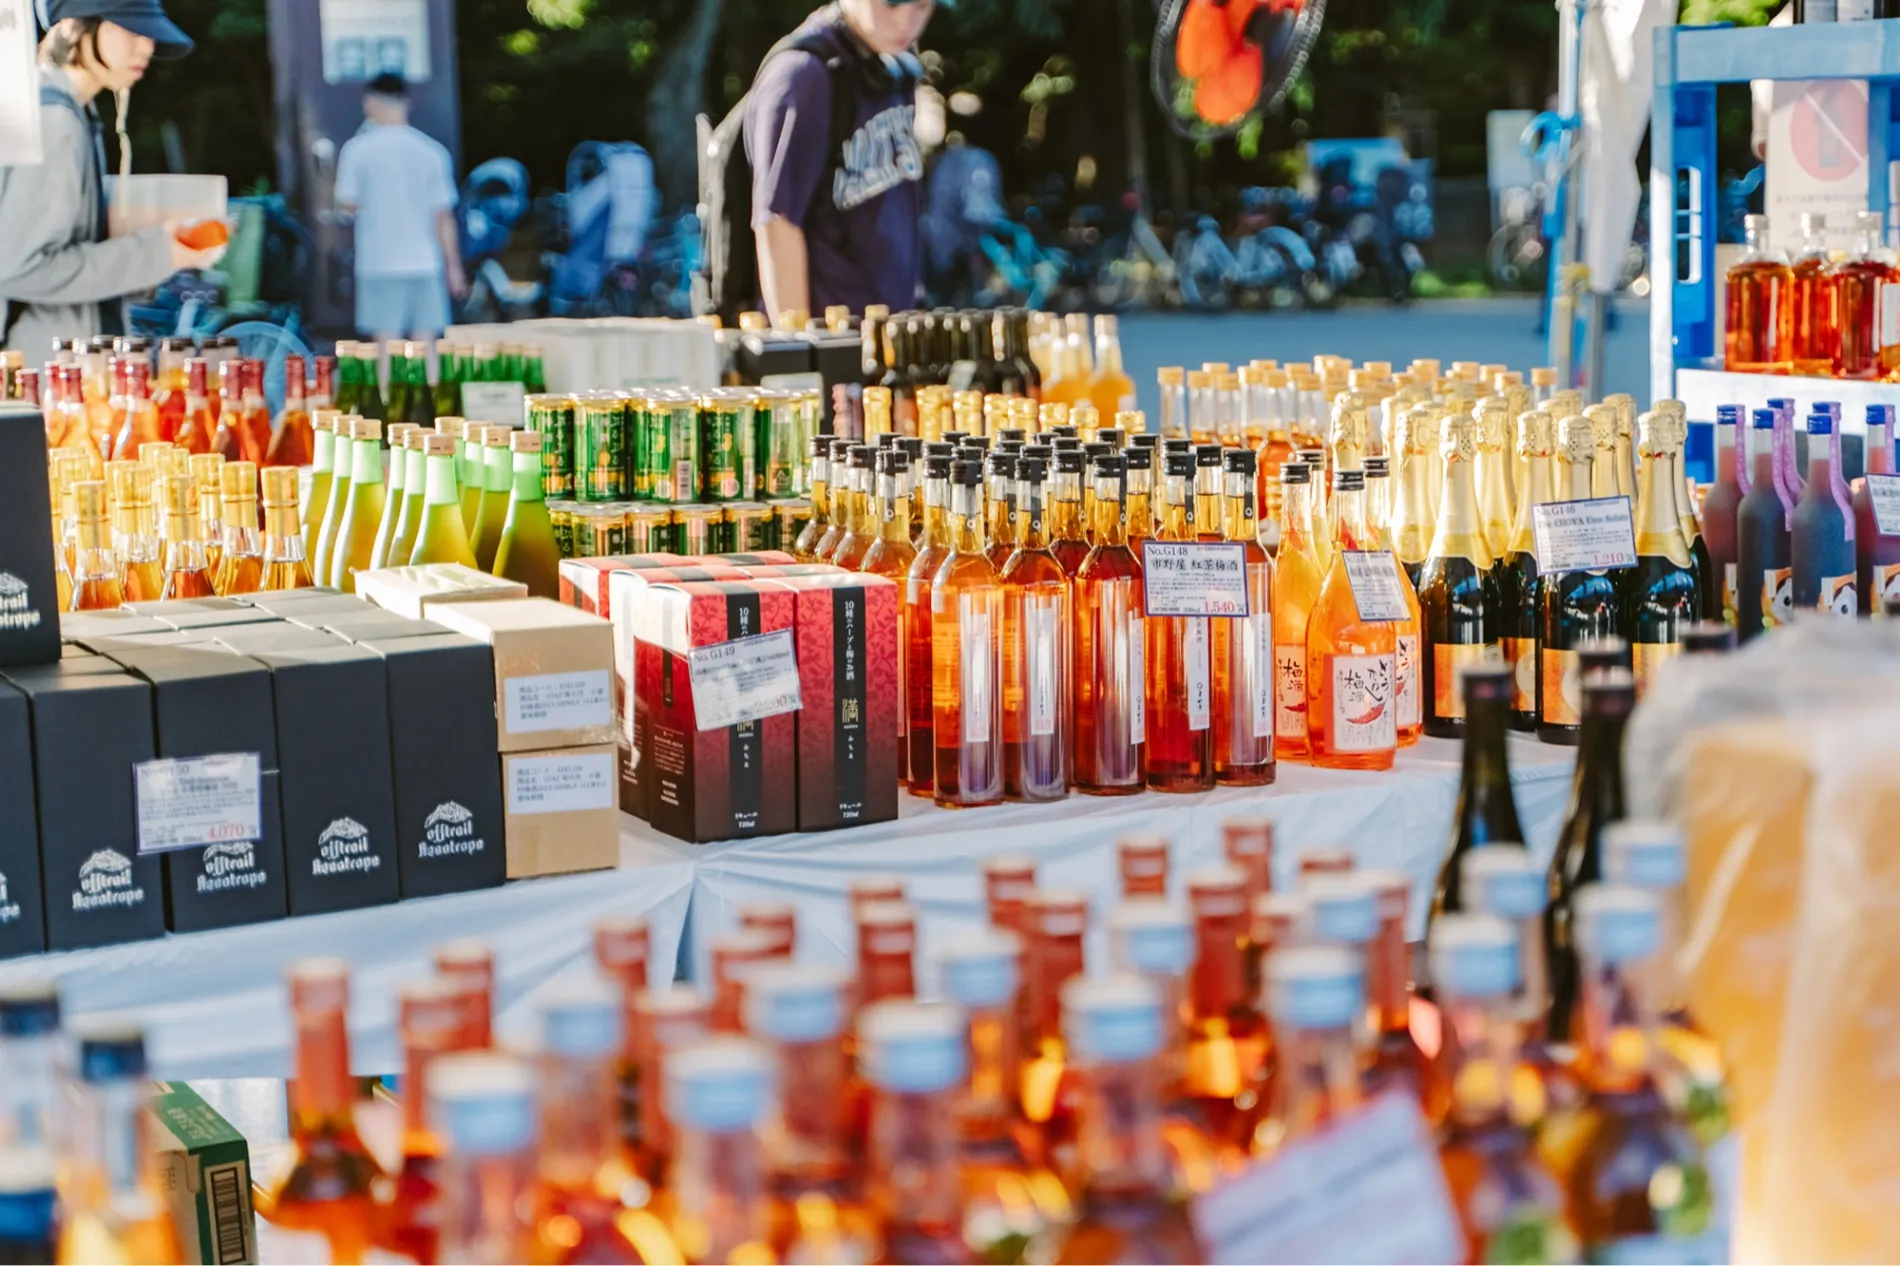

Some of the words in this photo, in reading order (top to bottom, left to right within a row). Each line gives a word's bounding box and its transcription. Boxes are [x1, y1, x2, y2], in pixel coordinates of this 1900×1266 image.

[1553, 517, 1585, 528] CHOYA
[1147, 545, 1189, 557] No.G148
[1152, 558, 1186, 571] 市野屋
[426, 819, 472, 843] offtrail
[320, 836, 369, 860] offtrail
[204, 851, 254, 876] offtrail
[80, 868, 132, 894] offtrail
